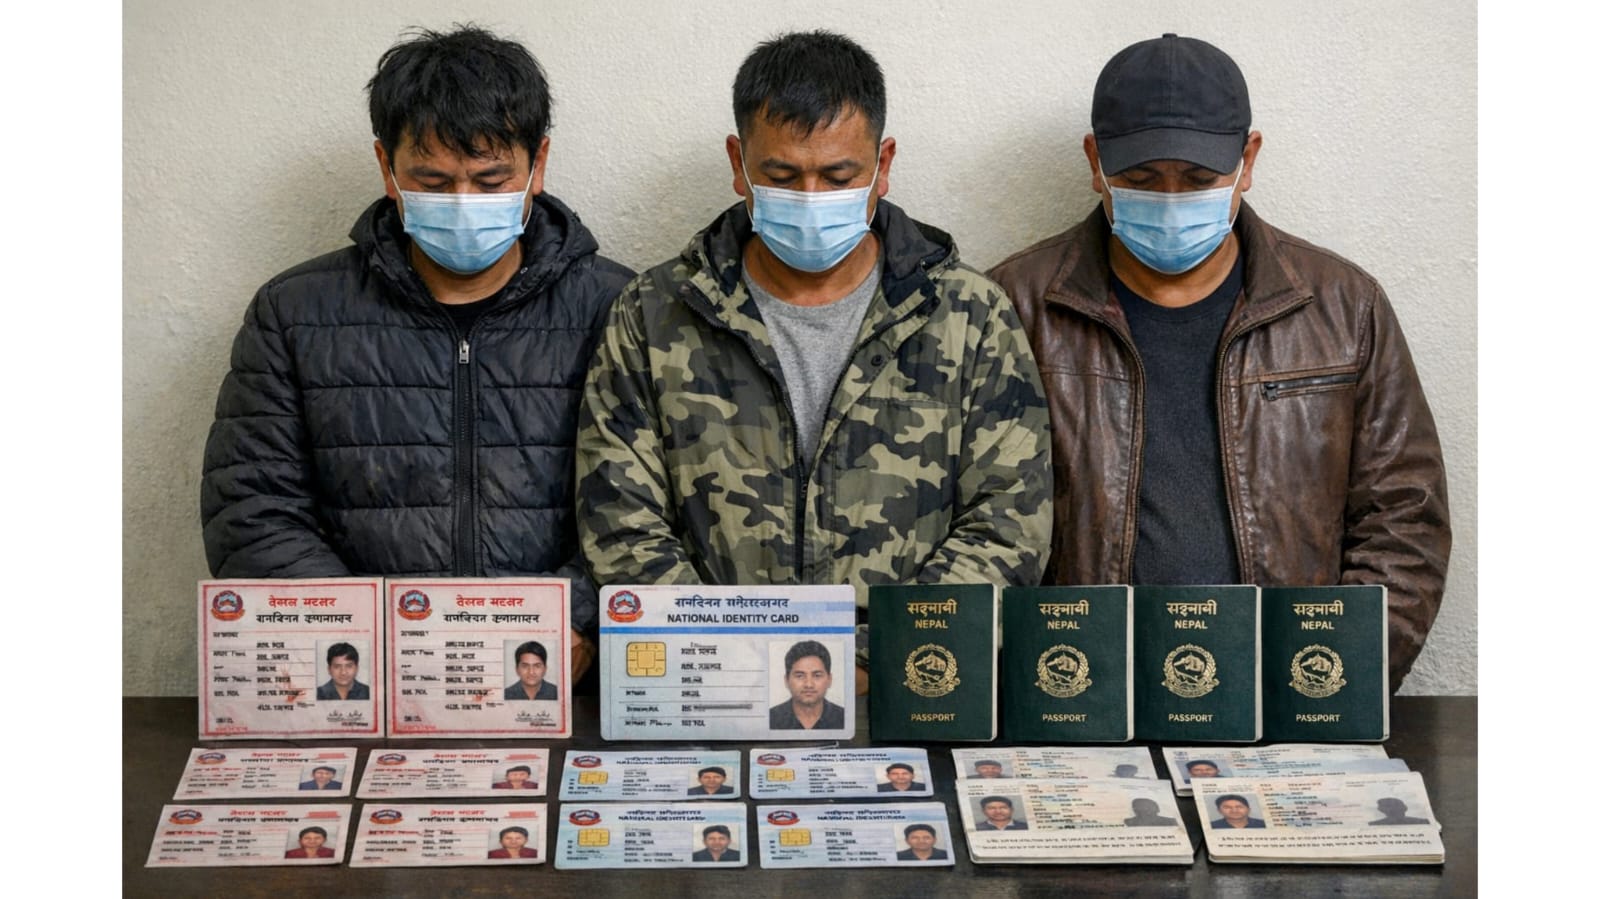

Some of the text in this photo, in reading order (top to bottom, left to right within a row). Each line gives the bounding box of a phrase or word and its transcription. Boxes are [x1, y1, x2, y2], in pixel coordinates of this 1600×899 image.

[667, 614, 799, 623] NATIONAL IDENTITY CARD
[915, 619, 948, 629] NEPAL
[1047, 620, 1080, 630] NEPAL
[1174, 619, 1208, 629] NEPAL
[1301, 620, 1334, 630] NEPAL
[910, 713, 956, 722] PASSPORT
[1042, 713, 1087, 722] PASSPORT
[1168, 713, 1213, 722] PASSPORT
[1296, 713, 1340, 722] PASSPORT
